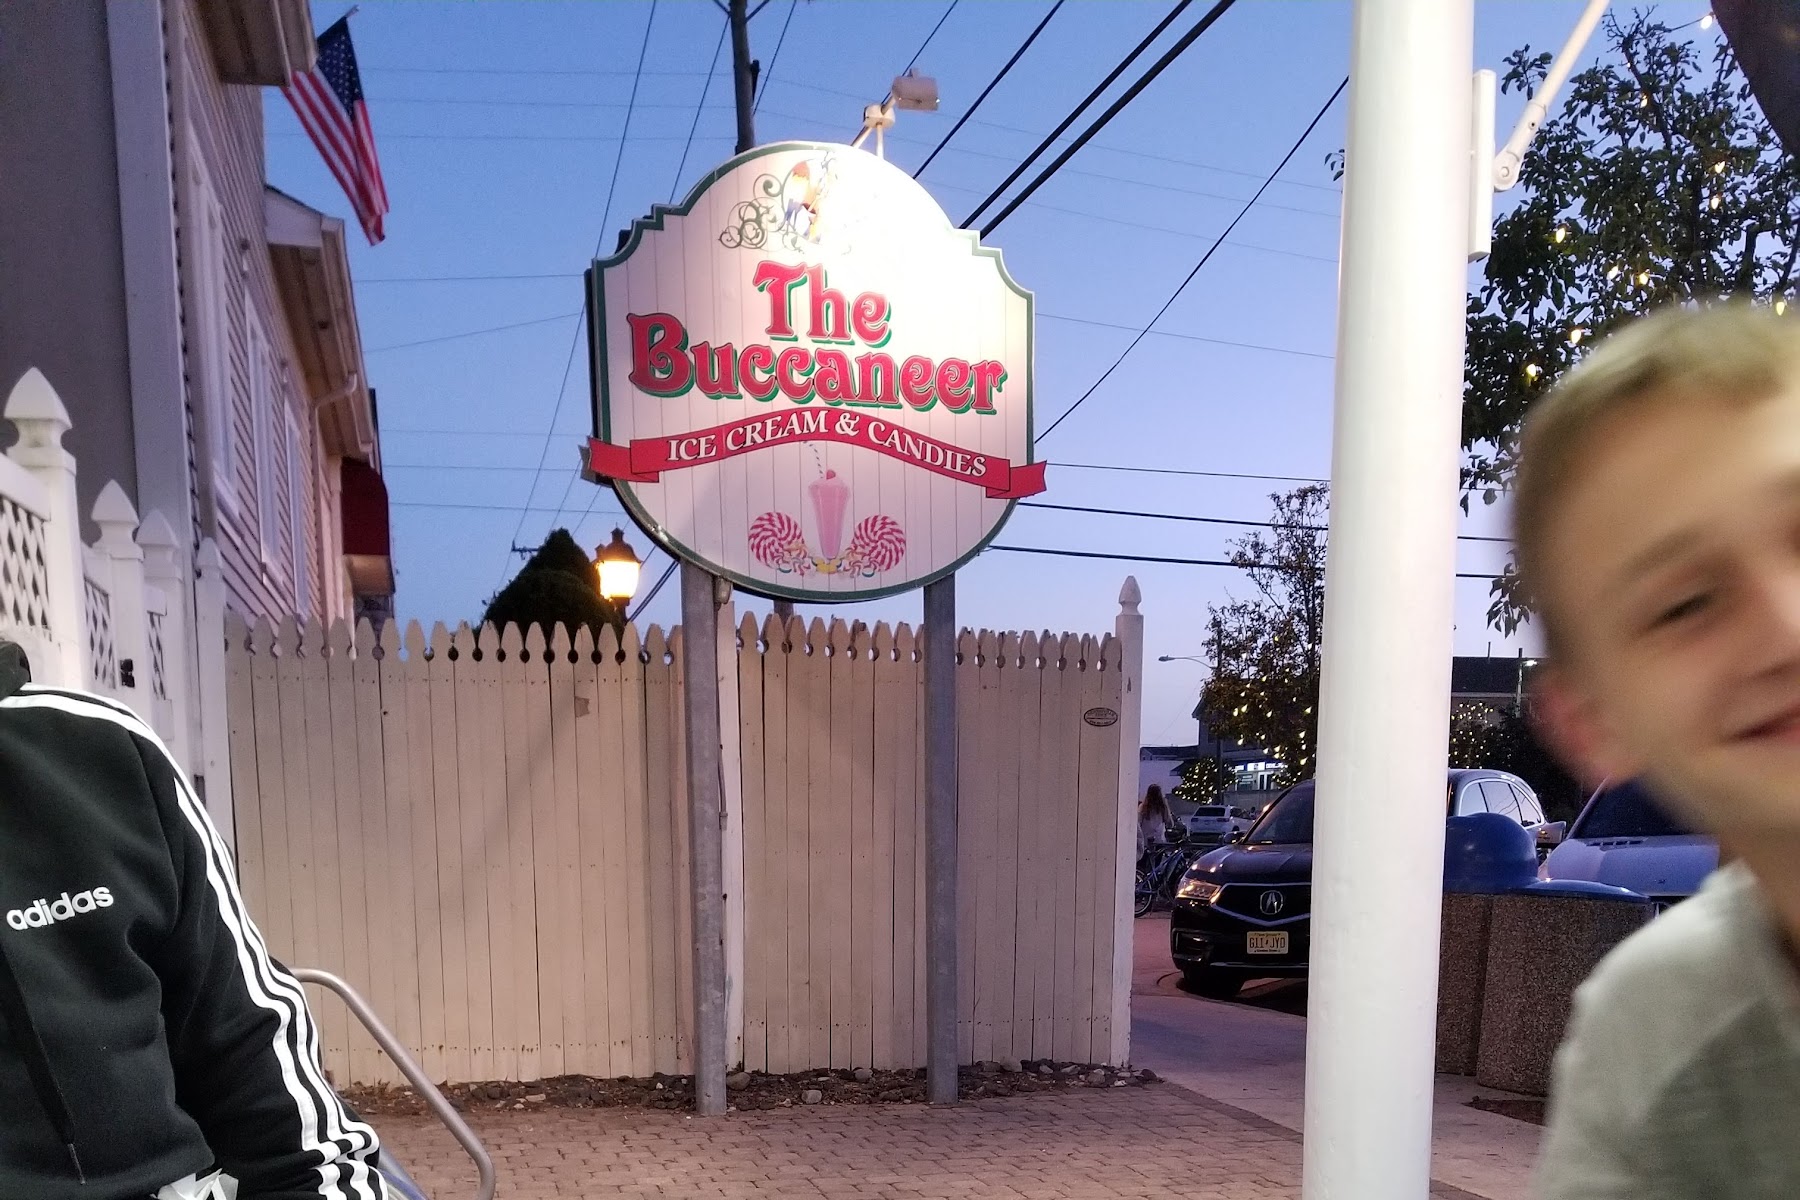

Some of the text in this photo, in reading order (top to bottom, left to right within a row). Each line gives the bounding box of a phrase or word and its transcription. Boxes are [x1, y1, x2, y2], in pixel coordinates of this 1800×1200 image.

[753, 259, 891, 347] The
[626, 312, 1008, 415] Buccaneer
[667, 410, 986, 477] ICE CREAM & CANDIES
[6, 886, 114, 931] adidas
